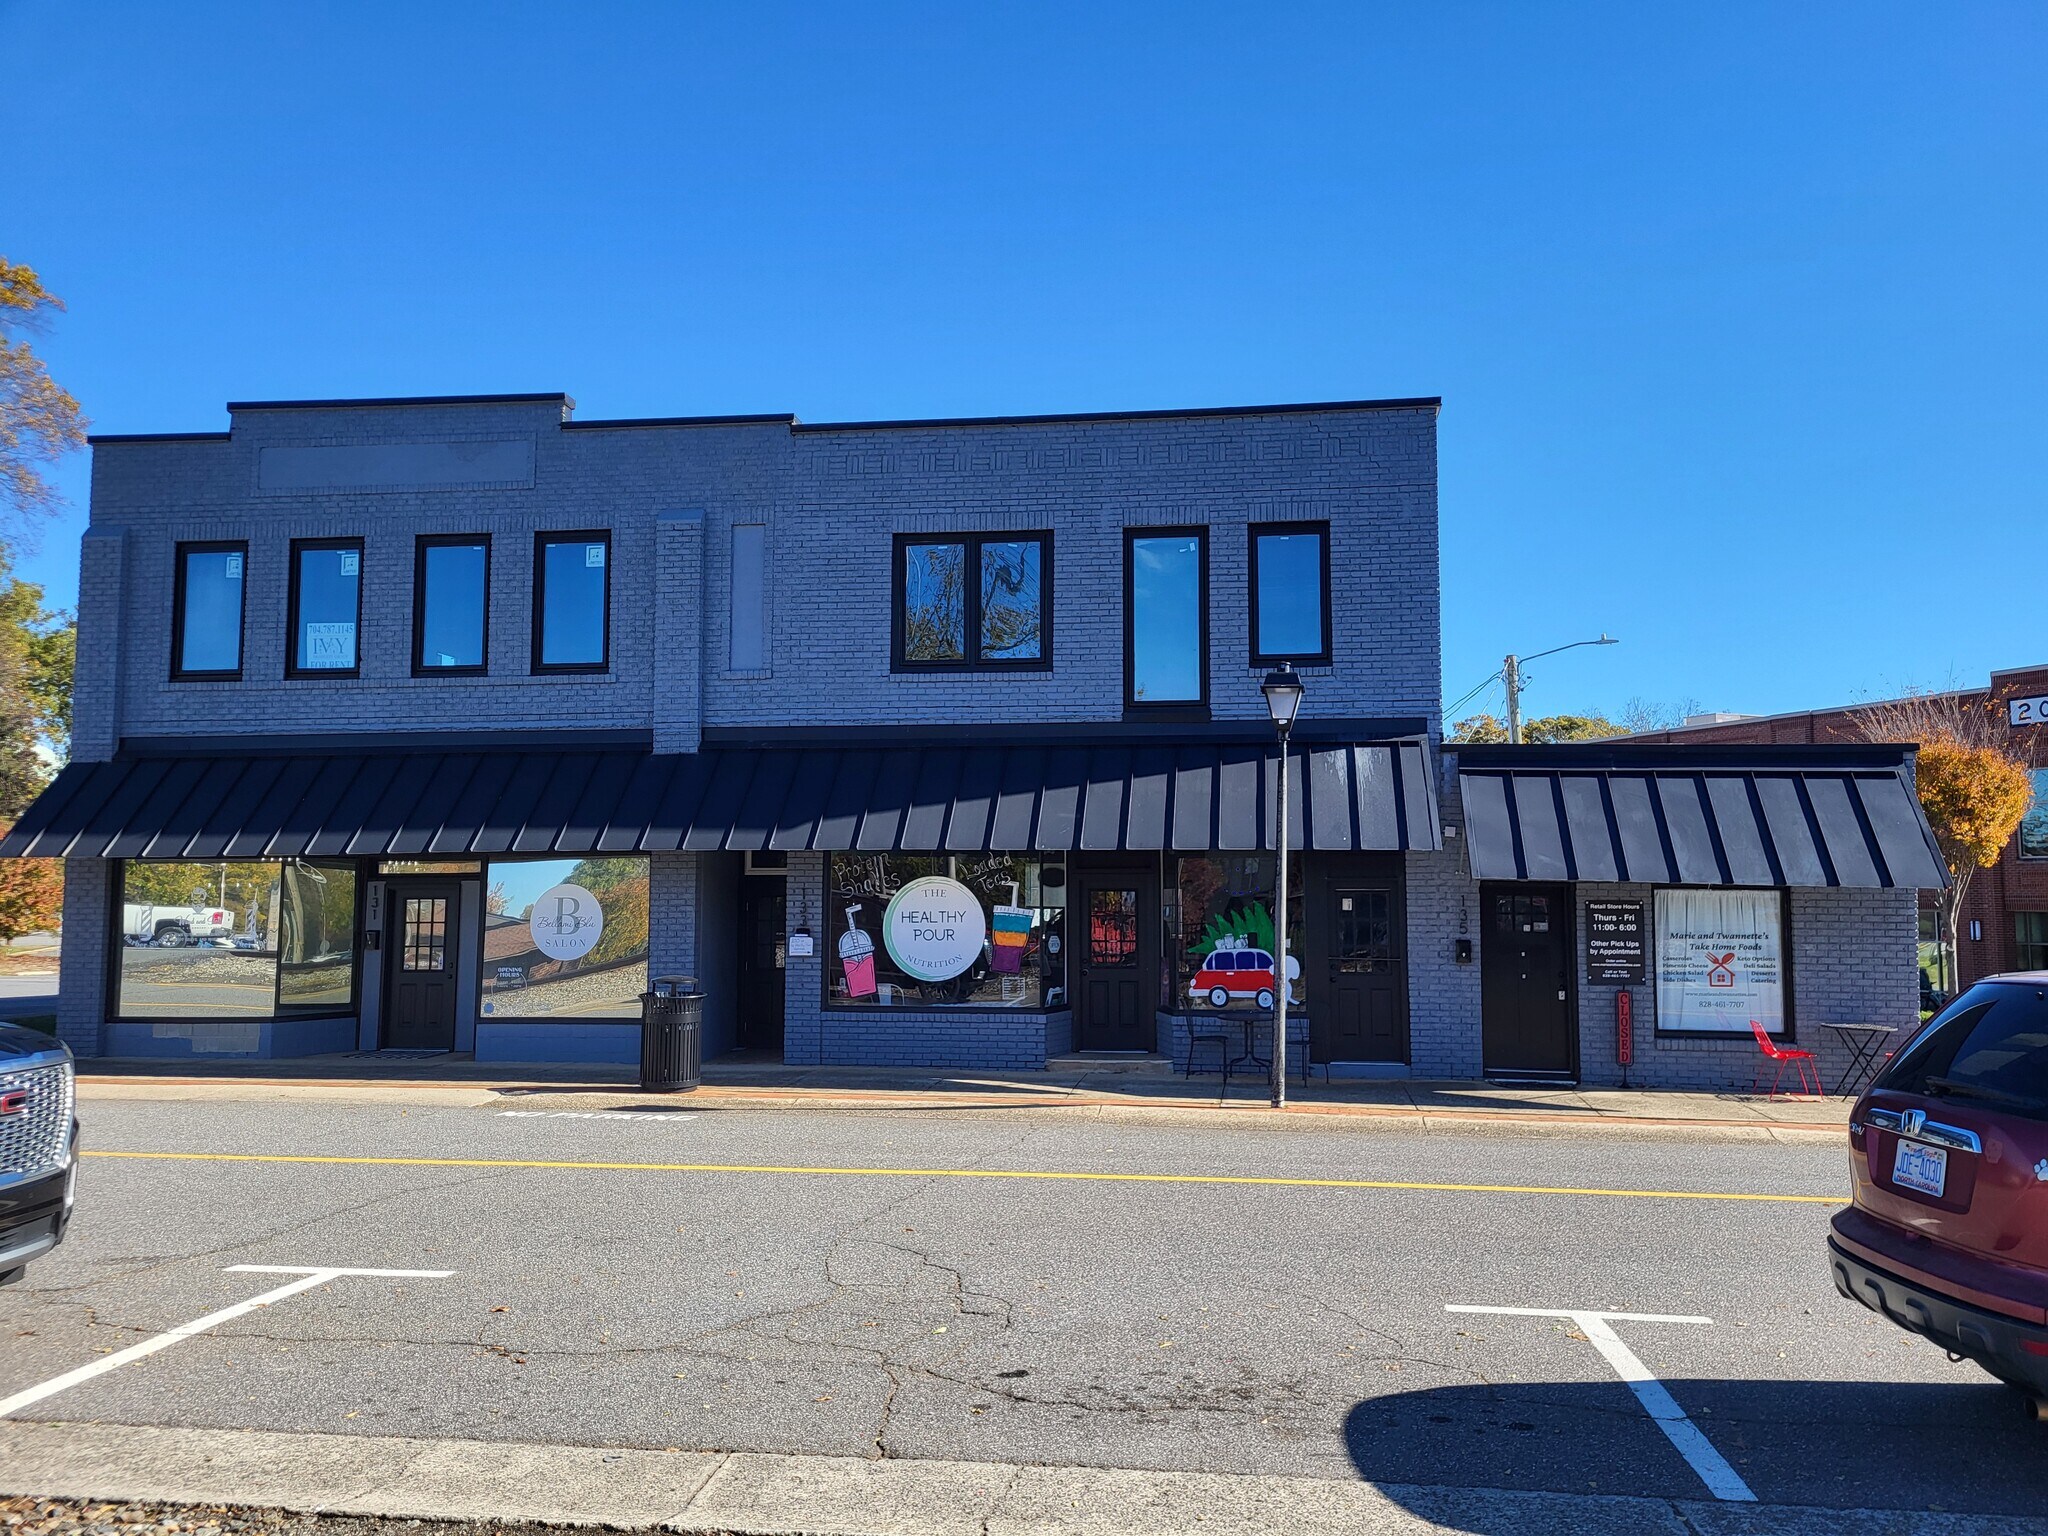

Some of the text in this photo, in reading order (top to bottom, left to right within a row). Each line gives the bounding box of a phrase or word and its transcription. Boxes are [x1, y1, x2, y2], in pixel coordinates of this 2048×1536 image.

[308, 624, 354, 635] 704.787.1145
[312, 637, 348, 655] IVY
[310, 660, 352, 668] FOR RENT
[958, 851, 1013, 880] Loaded
[974, 870, 1012, 894] Teas
[921, 888, 947, 898] THE
[370, 885, 379, 921] 131
[799, 888, 808, 927] 133
[552, 896, 581, 936] B
[901, 910, 967, 924] HEALTHY
[1459, 894, 1468, 935] 135
[1593, 913, 1617, 922] Thurs
[1624, 914, 1635, 922] Fri
[913, 928, 955, 942] POUR
[1669, 931, 1769, 940] Marie and Twannette's
[545, 938, 587, 948] SALON
[1626, 940, 1640, 948] Ups
[1689, 942, 1763, 951] Take Home Foods
[1589, 948, 1641, 956] by Appointment
[905, 953, 963, 969] NUTRITION
[1698, 1000, 1745, 1008] 828-461-7707
[1620, 993, 1629, 1062] CLOSED
[1896, 1151, 1942, 1184] JDE-4030
[1896, 1174, 1939, 1193] NORTH CAROLINA
